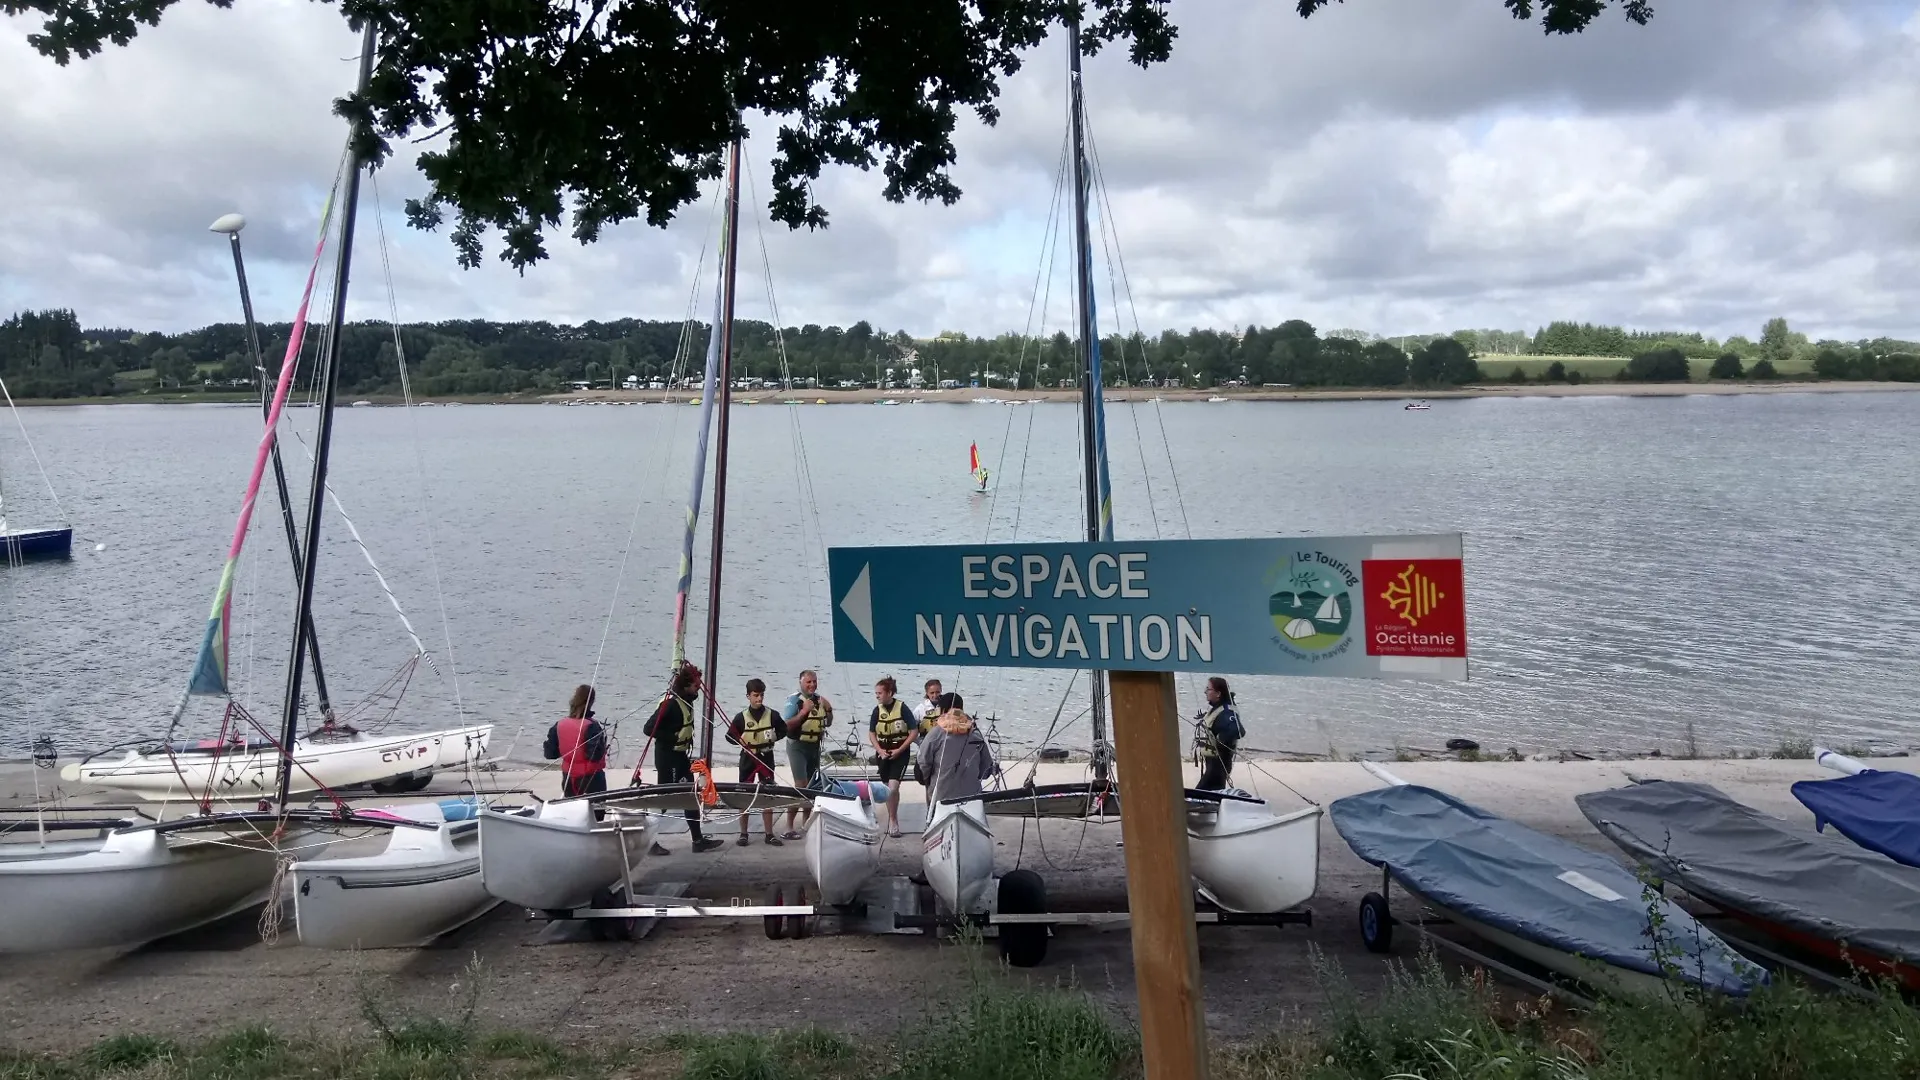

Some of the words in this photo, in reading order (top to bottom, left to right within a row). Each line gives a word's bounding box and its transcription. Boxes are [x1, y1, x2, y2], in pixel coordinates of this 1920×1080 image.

[962, 553, 1150, 599] ESPACE
[1297, 551, 1312, 562] Le
[1315, 551, 1360, 588] Touring
[914, 612, 1213, 662] NAVIGATION
[1321, 636, 1353, 661] navigue
[1375, 631, 1456, 645] Occitanie
[381, 746, 428, 763] CYVP
